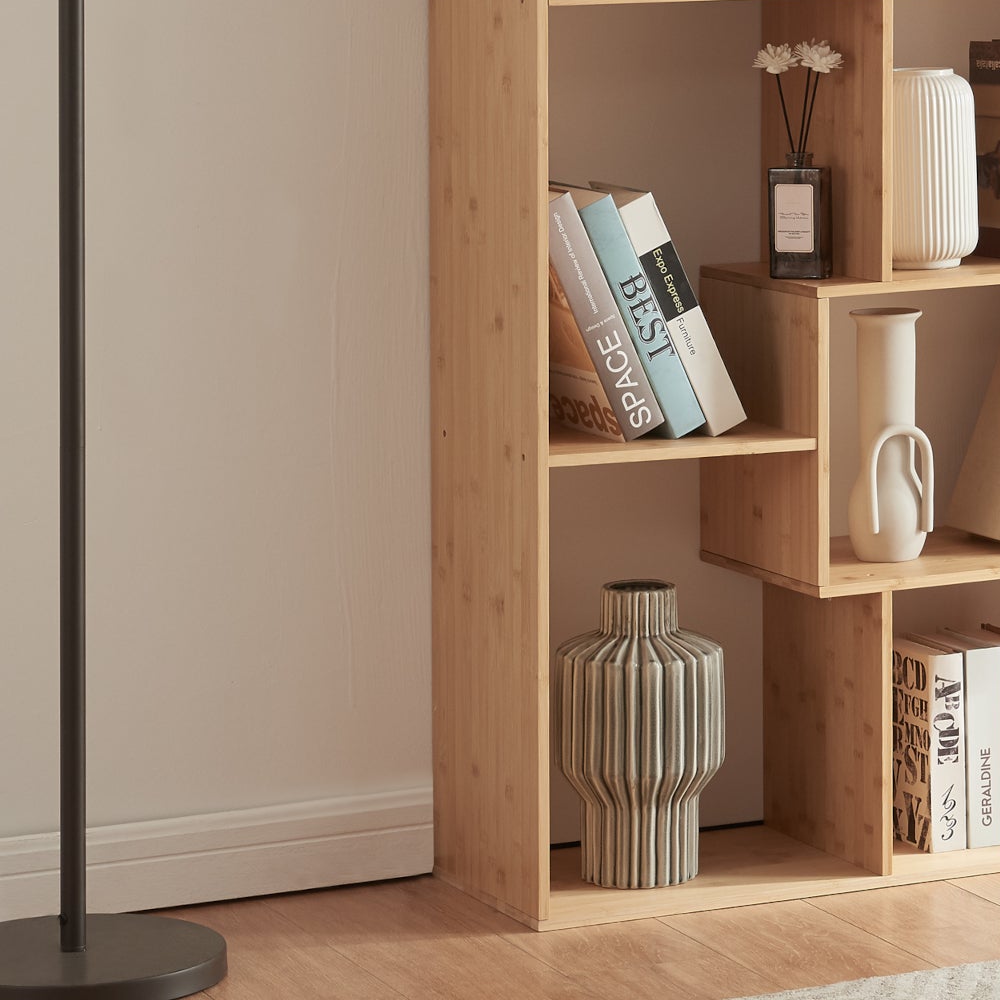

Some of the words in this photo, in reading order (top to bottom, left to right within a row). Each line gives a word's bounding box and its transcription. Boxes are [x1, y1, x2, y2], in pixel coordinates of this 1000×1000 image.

[617, 272, 677, 362] BEST
[653, 248, 668, 274] Expo
[664, 274, 685, 314] Express
[677, 317, 696, 356] Furniture
[597, 330, 652, 429] SPACE
[980, 747, 992, 827] GERALDINE
